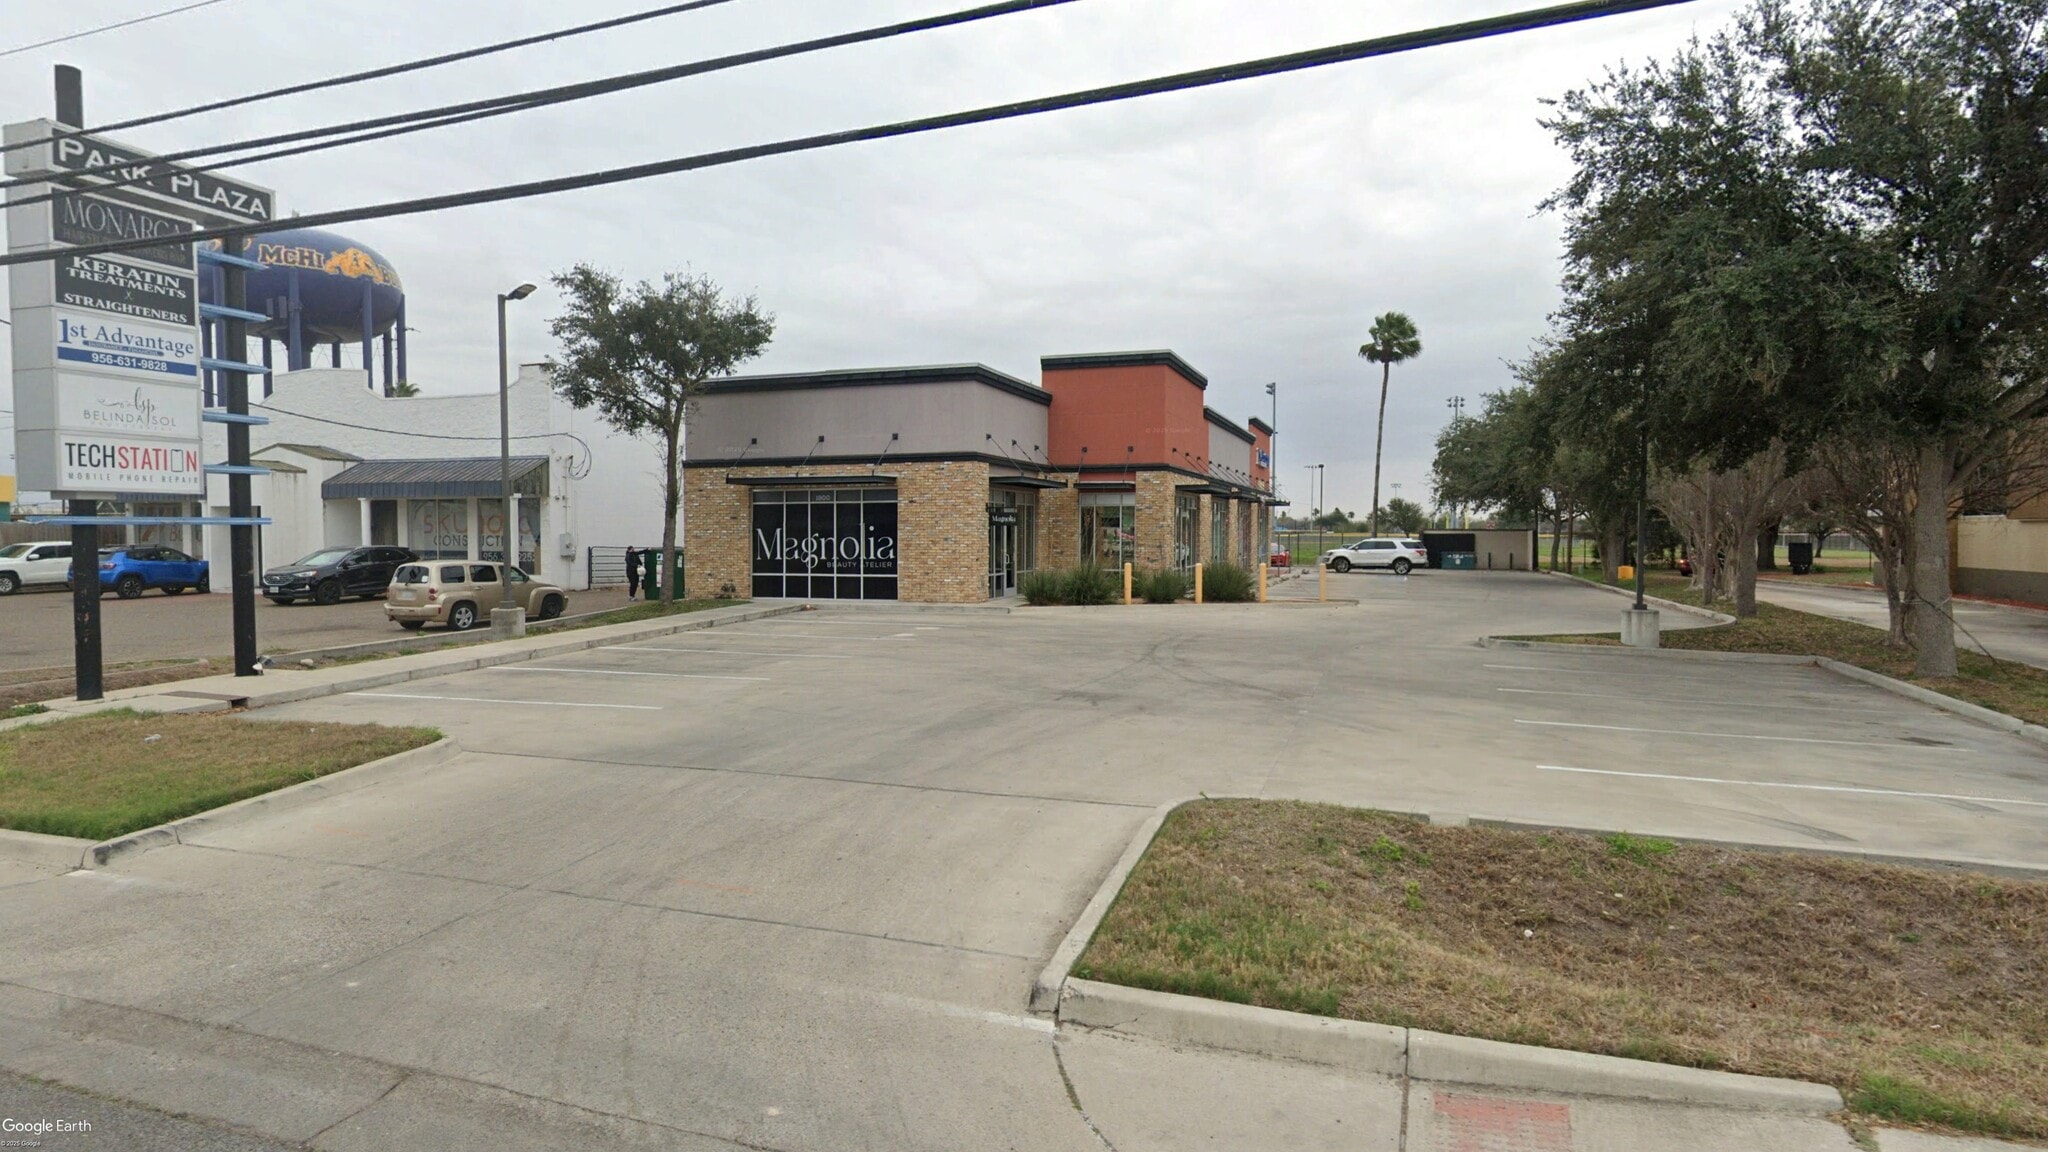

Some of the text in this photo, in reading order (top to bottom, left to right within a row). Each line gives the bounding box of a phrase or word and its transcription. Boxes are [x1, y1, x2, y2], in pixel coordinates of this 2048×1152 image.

[170, 169, 268, 218] PLAZA
[65, 267, 187, 299] TREATMENTS
[73, 256, 180, 289] KERATIN
[63, 292, 188, 324] STRAIGHTENERS
[58, 318, 195, 359] 1st Advantage
[91, 352, 168, 372] 956-631-9828
[83, 409, 143, 424] BELINDA
[151, 416, 177, 427] SOL
[68, 471, 199, 484] MOBILE PHONE REPAIR
[756, 522, 896, 569] Magnolia
